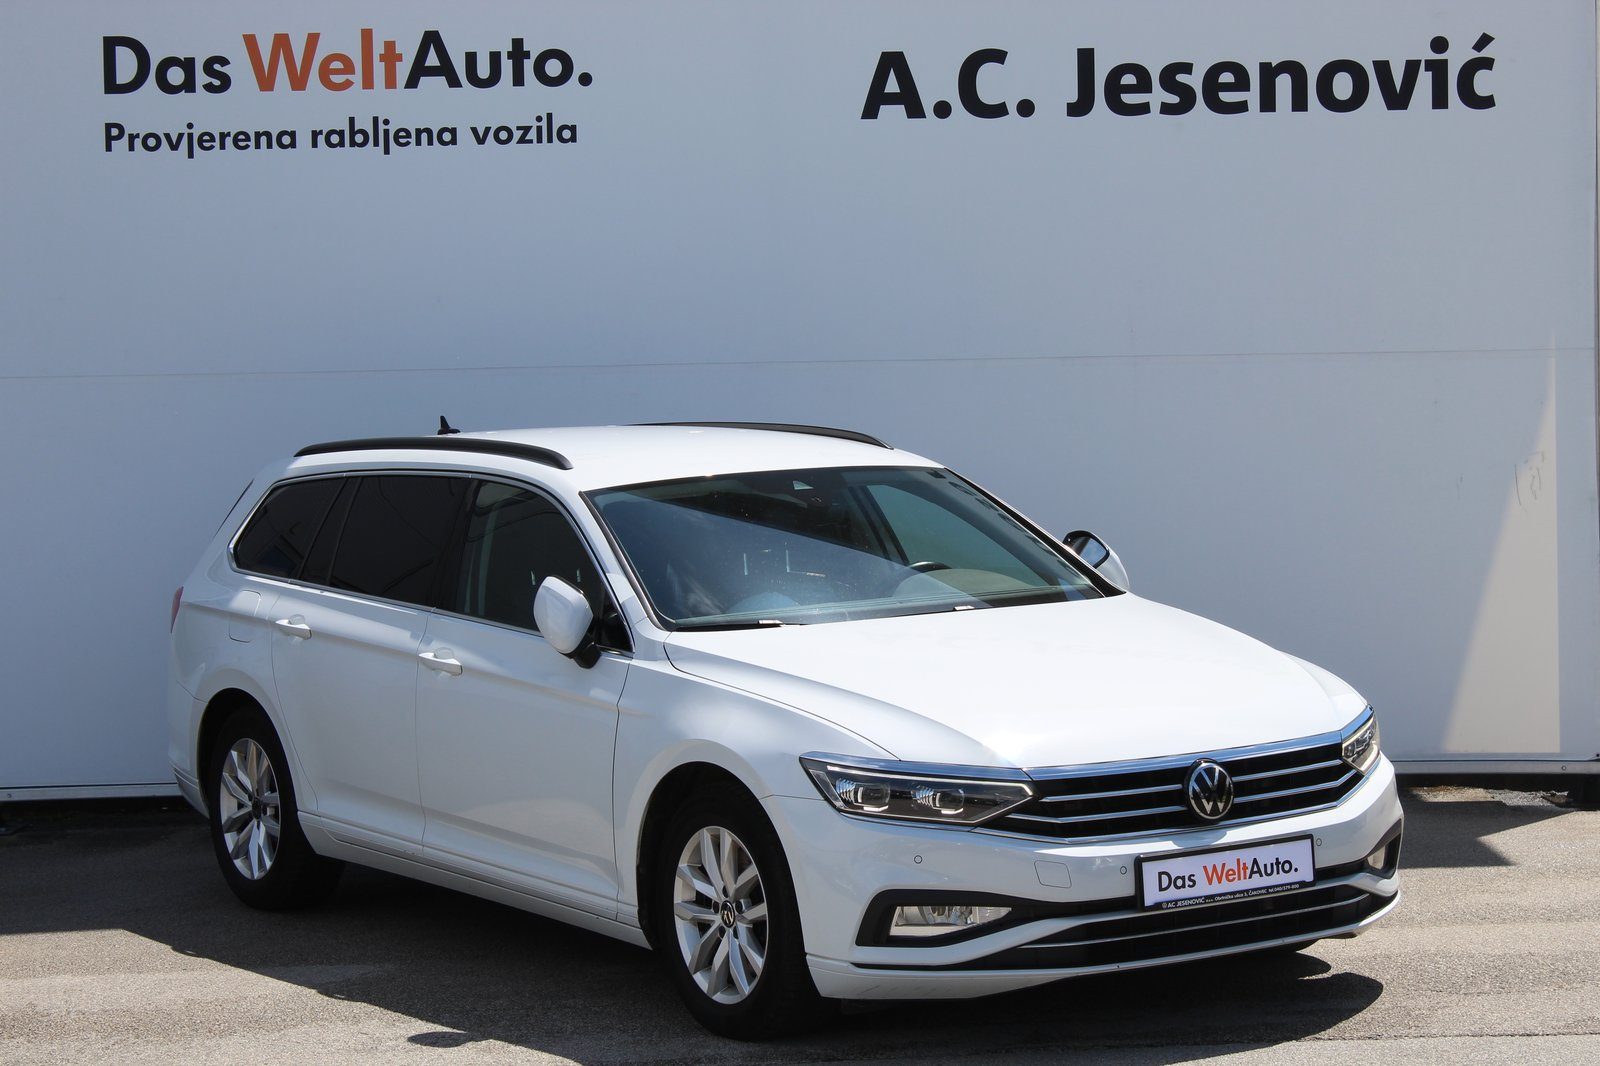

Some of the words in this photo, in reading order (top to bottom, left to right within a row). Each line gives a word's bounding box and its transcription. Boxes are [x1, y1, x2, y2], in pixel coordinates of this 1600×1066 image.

[103, 36, 231, 94] Das
[243, 29, 592, 91] WeltAuto.
[861, 49, 1035, 119] A.C.
[1067, 33, 1496, 117] Jesenović
[105, 122, 296, 159] Provjerena
[311, 116, 457, 155] rabljena
[470, 113, 577, 145] vozila
[1158, 871, 1197, 892] Das
[1202, 857, 1299, 886] WeltAuto.
